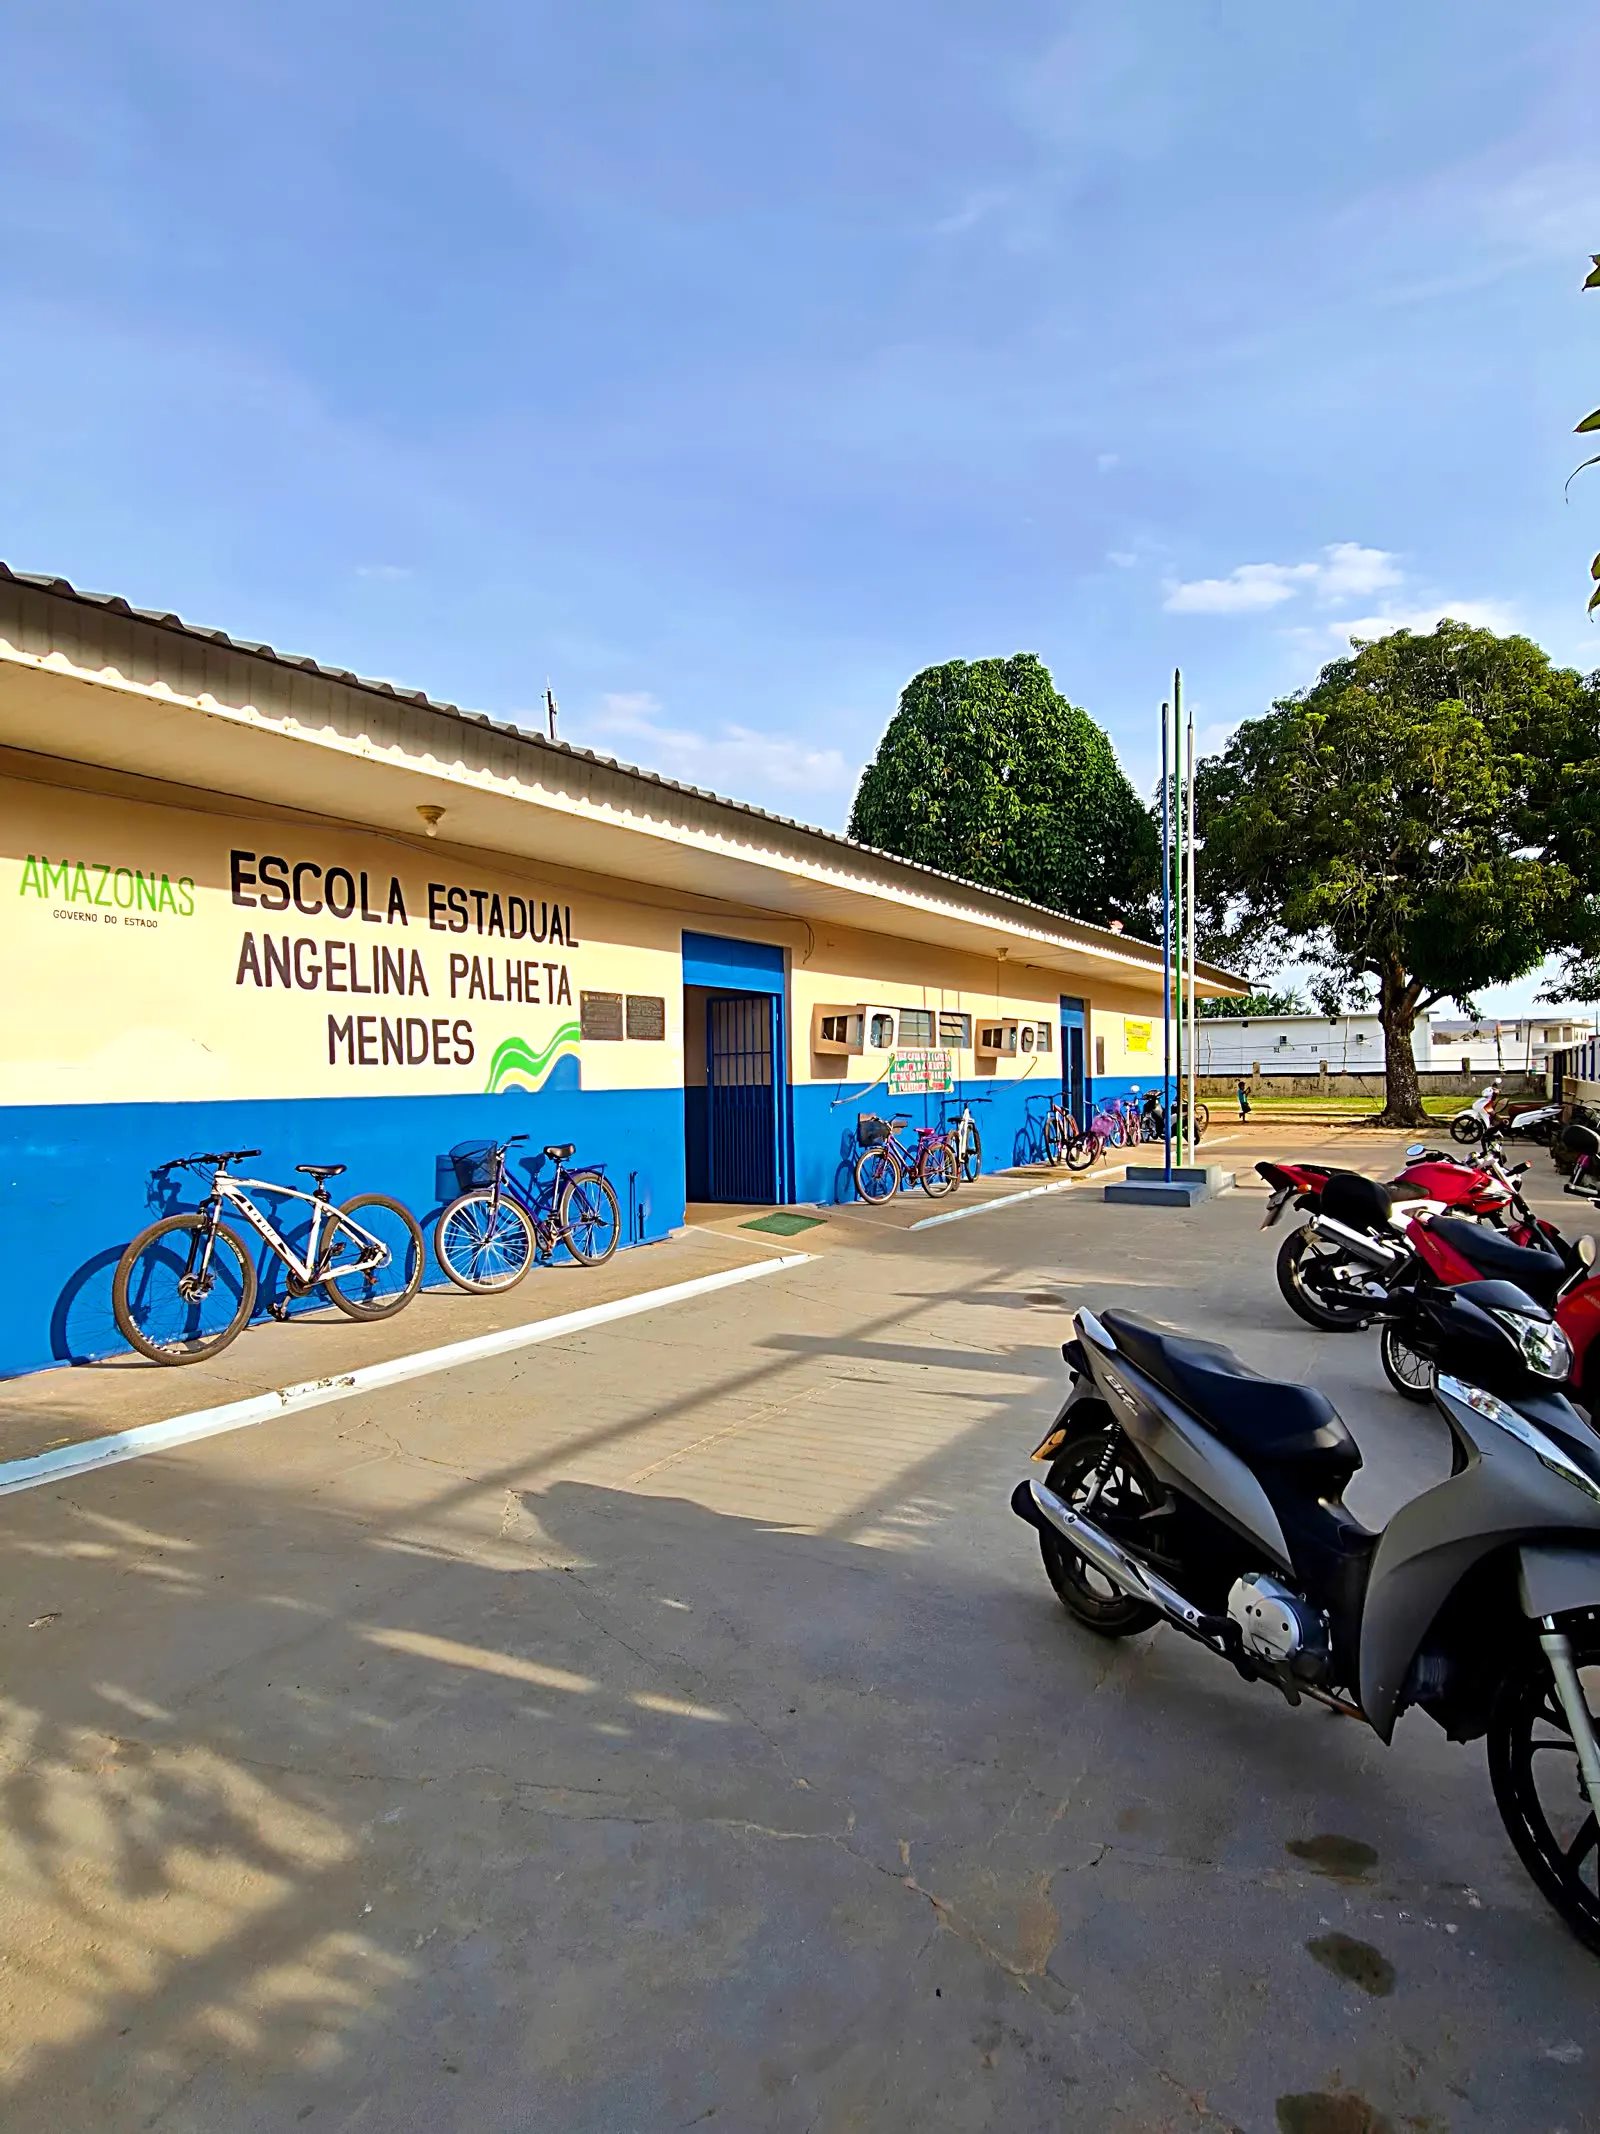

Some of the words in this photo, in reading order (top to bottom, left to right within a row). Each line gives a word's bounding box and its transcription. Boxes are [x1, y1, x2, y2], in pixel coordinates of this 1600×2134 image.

[19, 854, 195, 917] AMAZONAS
[230, 849, 408, 927] ESCOLA
[427, 883, 579, 948] ESTADUAL
[52, 909, 98, 923] GOVERNO
[104, 914, 117, 924] DO
[124, 917, 158, 928] ESTADO
[235, 931, 429, 997] ANGELINA
[449, 953, 572, 1006] PALHETA
[328, 1014, 475, 1066] MENDES
